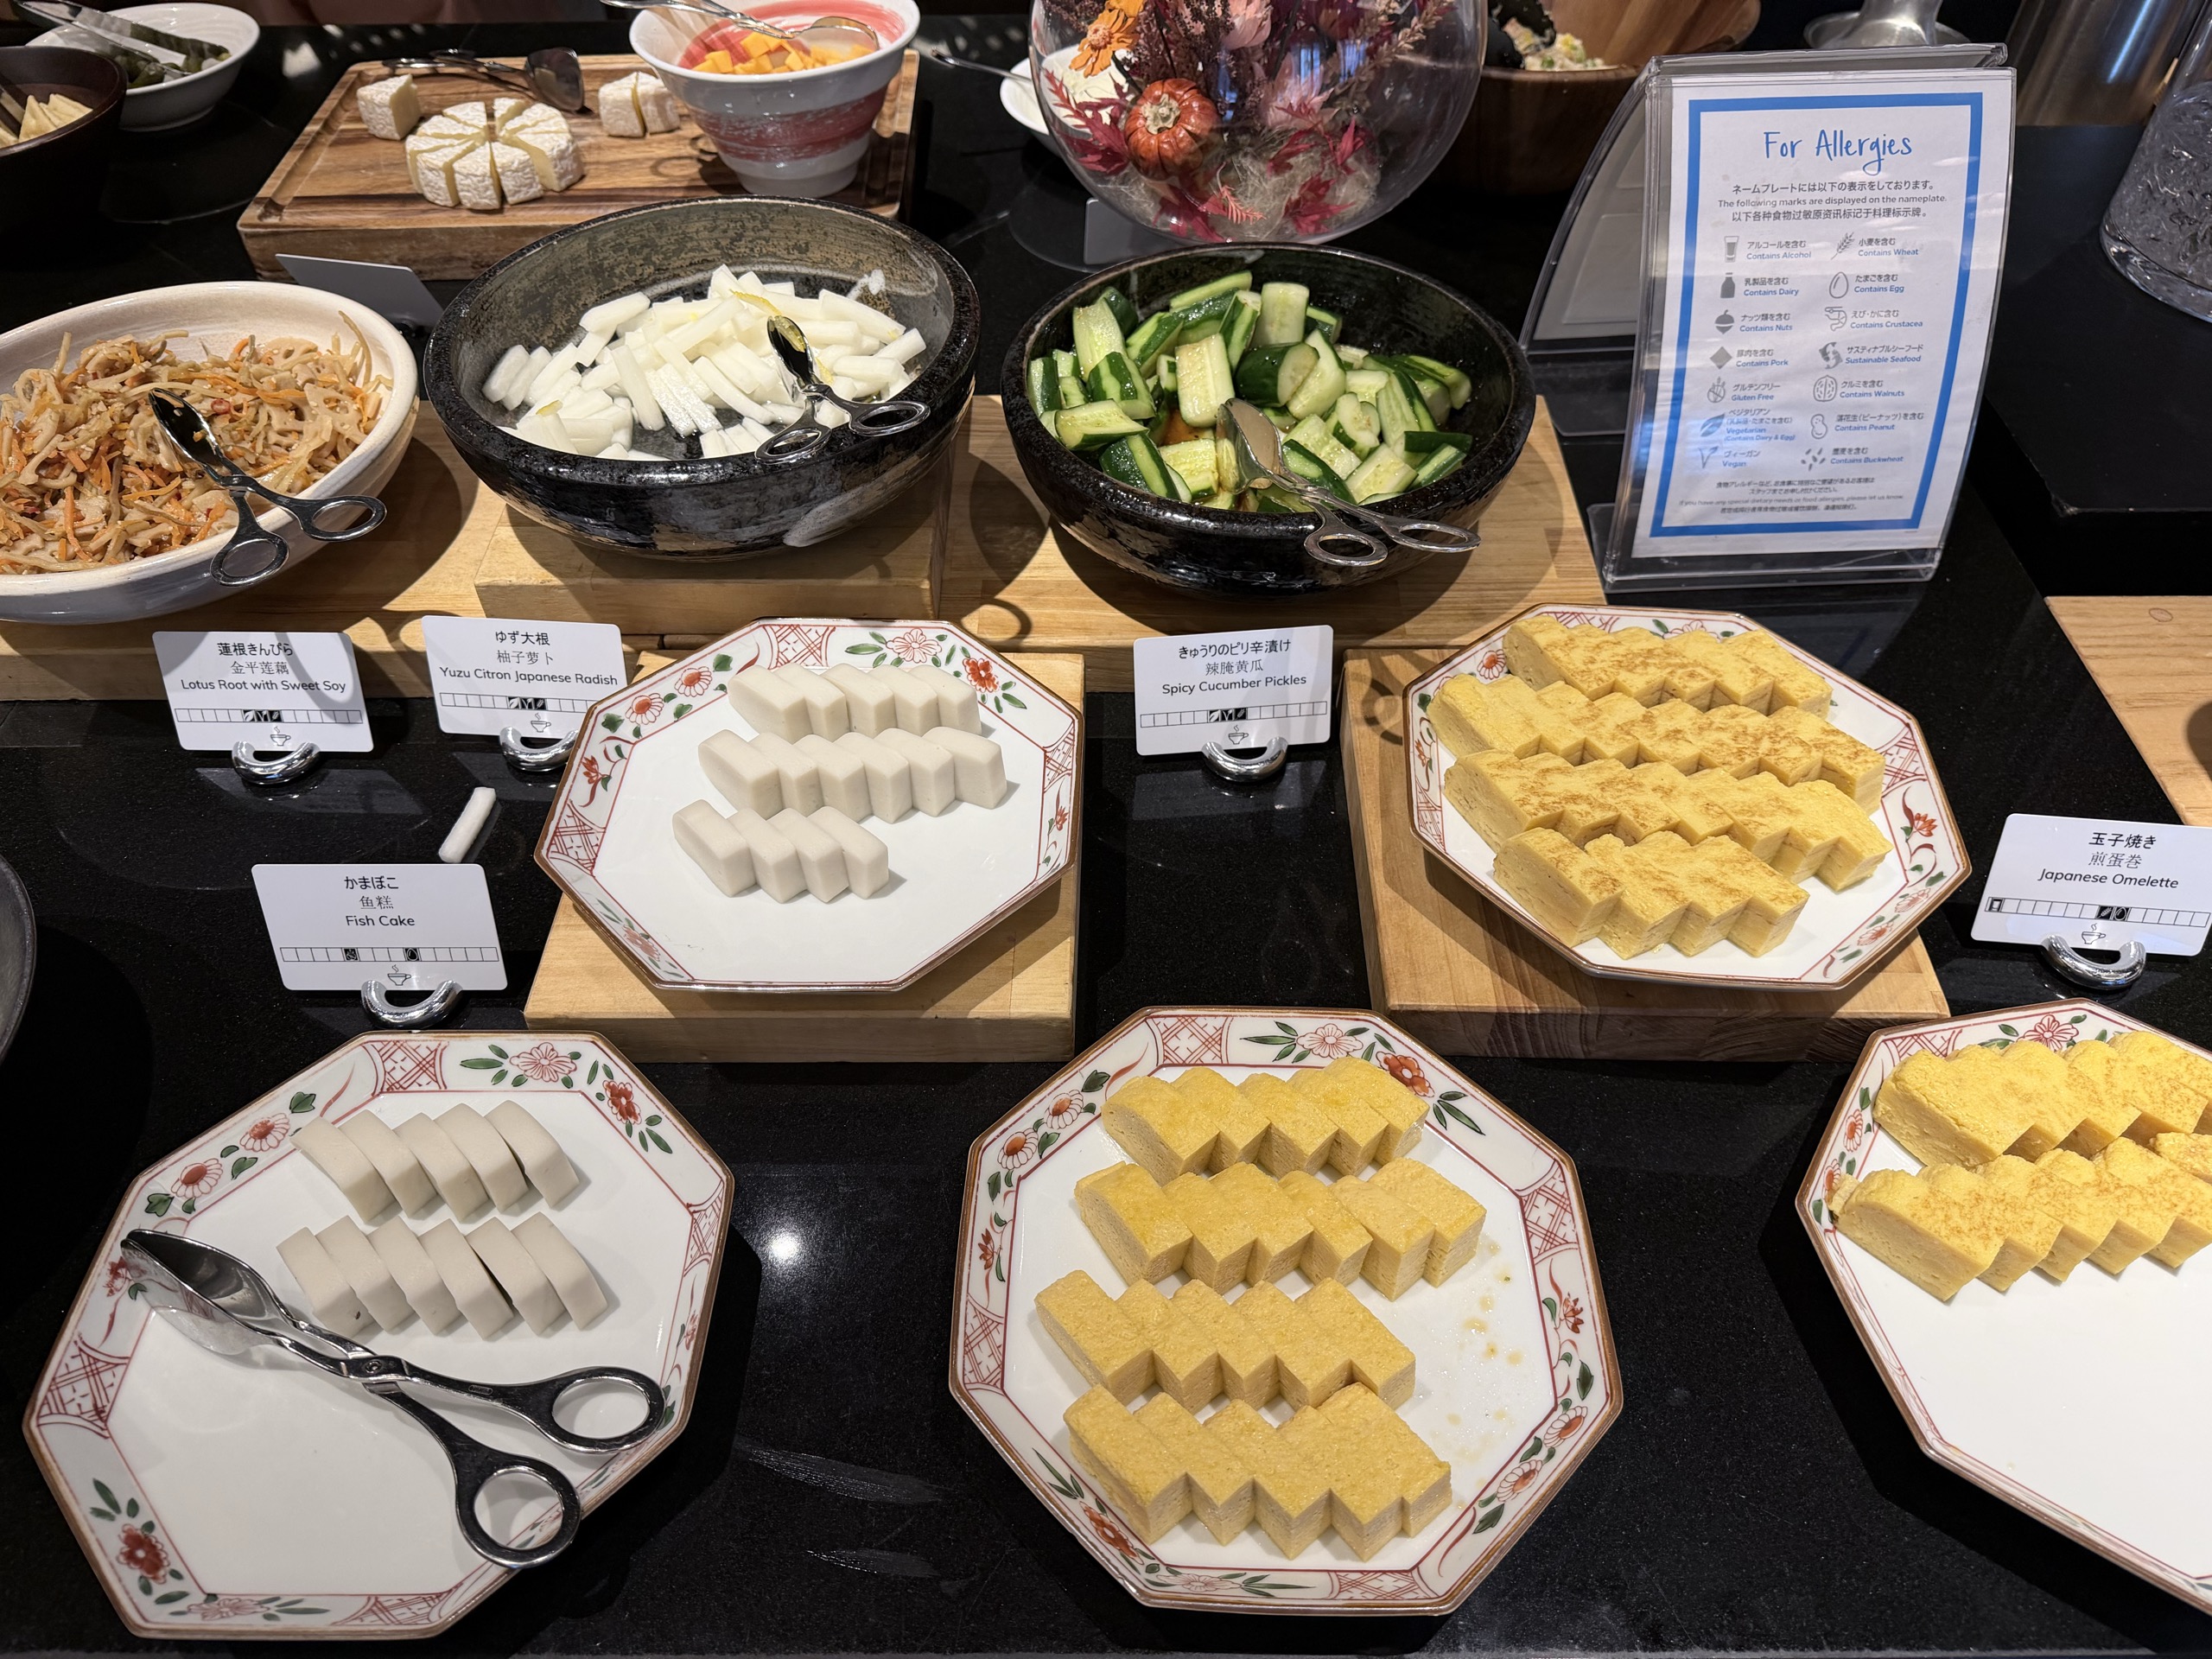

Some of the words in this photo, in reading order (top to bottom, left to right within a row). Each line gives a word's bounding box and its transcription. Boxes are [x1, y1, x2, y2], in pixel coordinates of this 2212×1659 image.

[1763, 131, 1802, 159] For
[1815, 130, 1912, 176] Allergies
[1732, 180, 1935, 195] ネームプレートには以下の表示をしております。
[1718, 200, 1734, 208] The
[1736, 198, 1777, 209] following
[1778, 197, 1807, 206] marks
[1825, 195, 1867, 207] displayed
[1881, 194, 1897, 203] the
[1897, 194, 1947, 205] nameplate.
[1732, 207, 1928, 222] 以下各种食物过敏原资讯标记于料理标示牌。
[1747, 239, 1807, 250] アルコールを含む
[1858, 238, 1896, 247] 小麦を含む
[1746, 251, 1780, 260] Contains
[1782, 251, 1812, 259] Alcohol
[1858, 249, 1891, 257] Contains
[1744, 276, 1789, 286] 乳製品を含む
[1854, 273, 1899, 283] たまごを含む
[1744, 288, 1777, 296] Contains
[1779, 288, 1800, 297] Dairy
[1890, 284, 1904, 294] Egg
[1740, 312, 1791, 321] ナッツ類を含む
[1851, 309, 1899, 319] えび・かに含む
[1739, 324, 1774, 333] Contains
[1775, 323, 1793, 332] Nuts
[1850, 321, 1884, 329] Contains
[1885, 320, 1923, 328] Crustacea
[1847, 343, 1924, 353] サスティナブルシーフード
[1735, 359, 1769, 368] Contains
[1845, 355, 1889, 365] Sustainable
[1890, 354, 1922, 364] Seafood
[1732, 383, 1781, 391] グルテンフリー
[1840, 378, 1884, 389] クルミを含む
[1840, 391, 1873, 399] Contains
[1874, 389, 1905, 397] Walnuts
[1780, 434, 1796, 442] Egg)
[1722, 460, 1747, 469] Vegan
[1863, 455, 1904, 464] Buckwheat
[495, 630, 550, 646] ゆず大根
[217, 642, 294, 657] 蓮根きんぴら
[1179, 639, 1292, 659] きゅうりのピリ辛漬け
[496, 650, 554, 665] 柚子萝卜
[230, 660, 289, 675] 金平莲藕
[1205, 659, 1263, 677] 辣腌黄瓜
[439, 666, 471, 678] Yuzu
[474, 668, 512, 680] Citron
[515, 671, 572, 683] Japanese
[575, 673, 618, 685] Radish
[181, 679, 215, 690] Lotus
[218, 679, 249, 690] Root
[250, 679, 278, 690] with
[281, 680, 321, 690] Sweet
[323, 680, 346, 693] Soy
[1162, 682, 1196, 696] Spicy
[1198, 678, 1262, 691] Cucumber
[1265, 674, 1307, 688] Pickles
[2088, 831, 2157, 849] 玉子焼き
[344, 875, 399, 890] かまぼこ
[2037, 868, 2108, 884] Japanese
[2112, 873, 2179, 888] Omelette
[359, 895, 394, 909] 鱼糕
[345, 914, 375, 926] Fish
[378, 914, 416, 926] Cake
